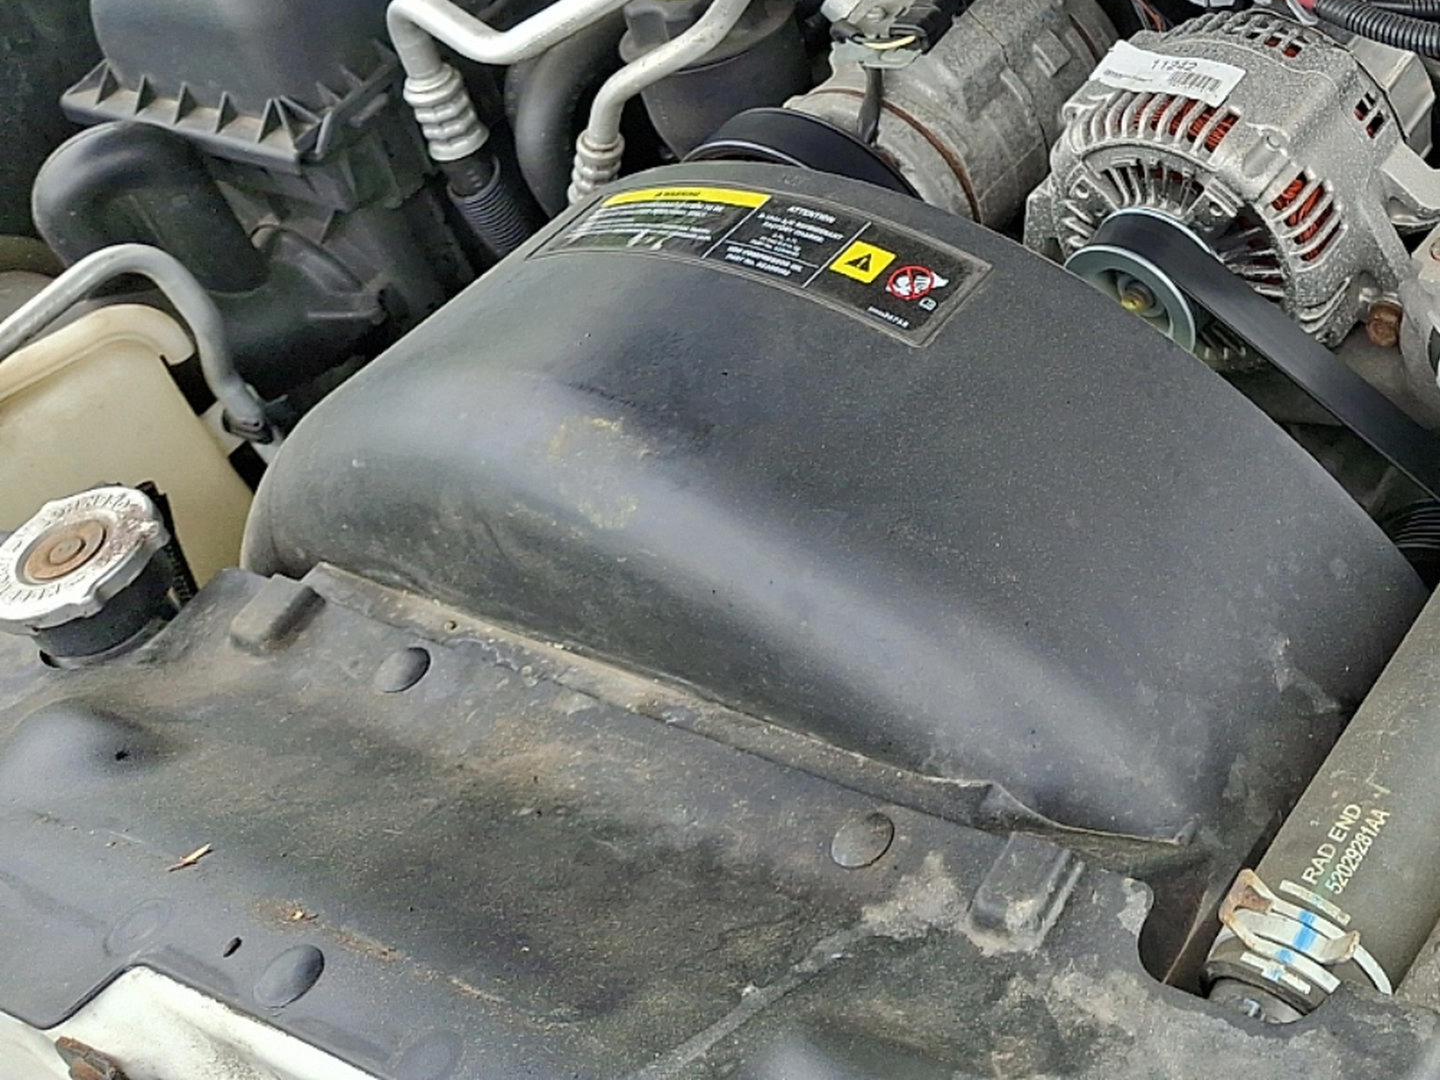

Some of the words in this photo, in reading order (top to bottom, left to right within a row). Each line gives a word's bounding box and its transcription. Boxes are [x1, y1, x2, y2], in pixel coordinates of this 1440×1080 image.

[1302, 844, 1336, 885] RAD
[1330, 805, 1361, 842] END
[1332, 809, 1390, 894] 52029281AA
